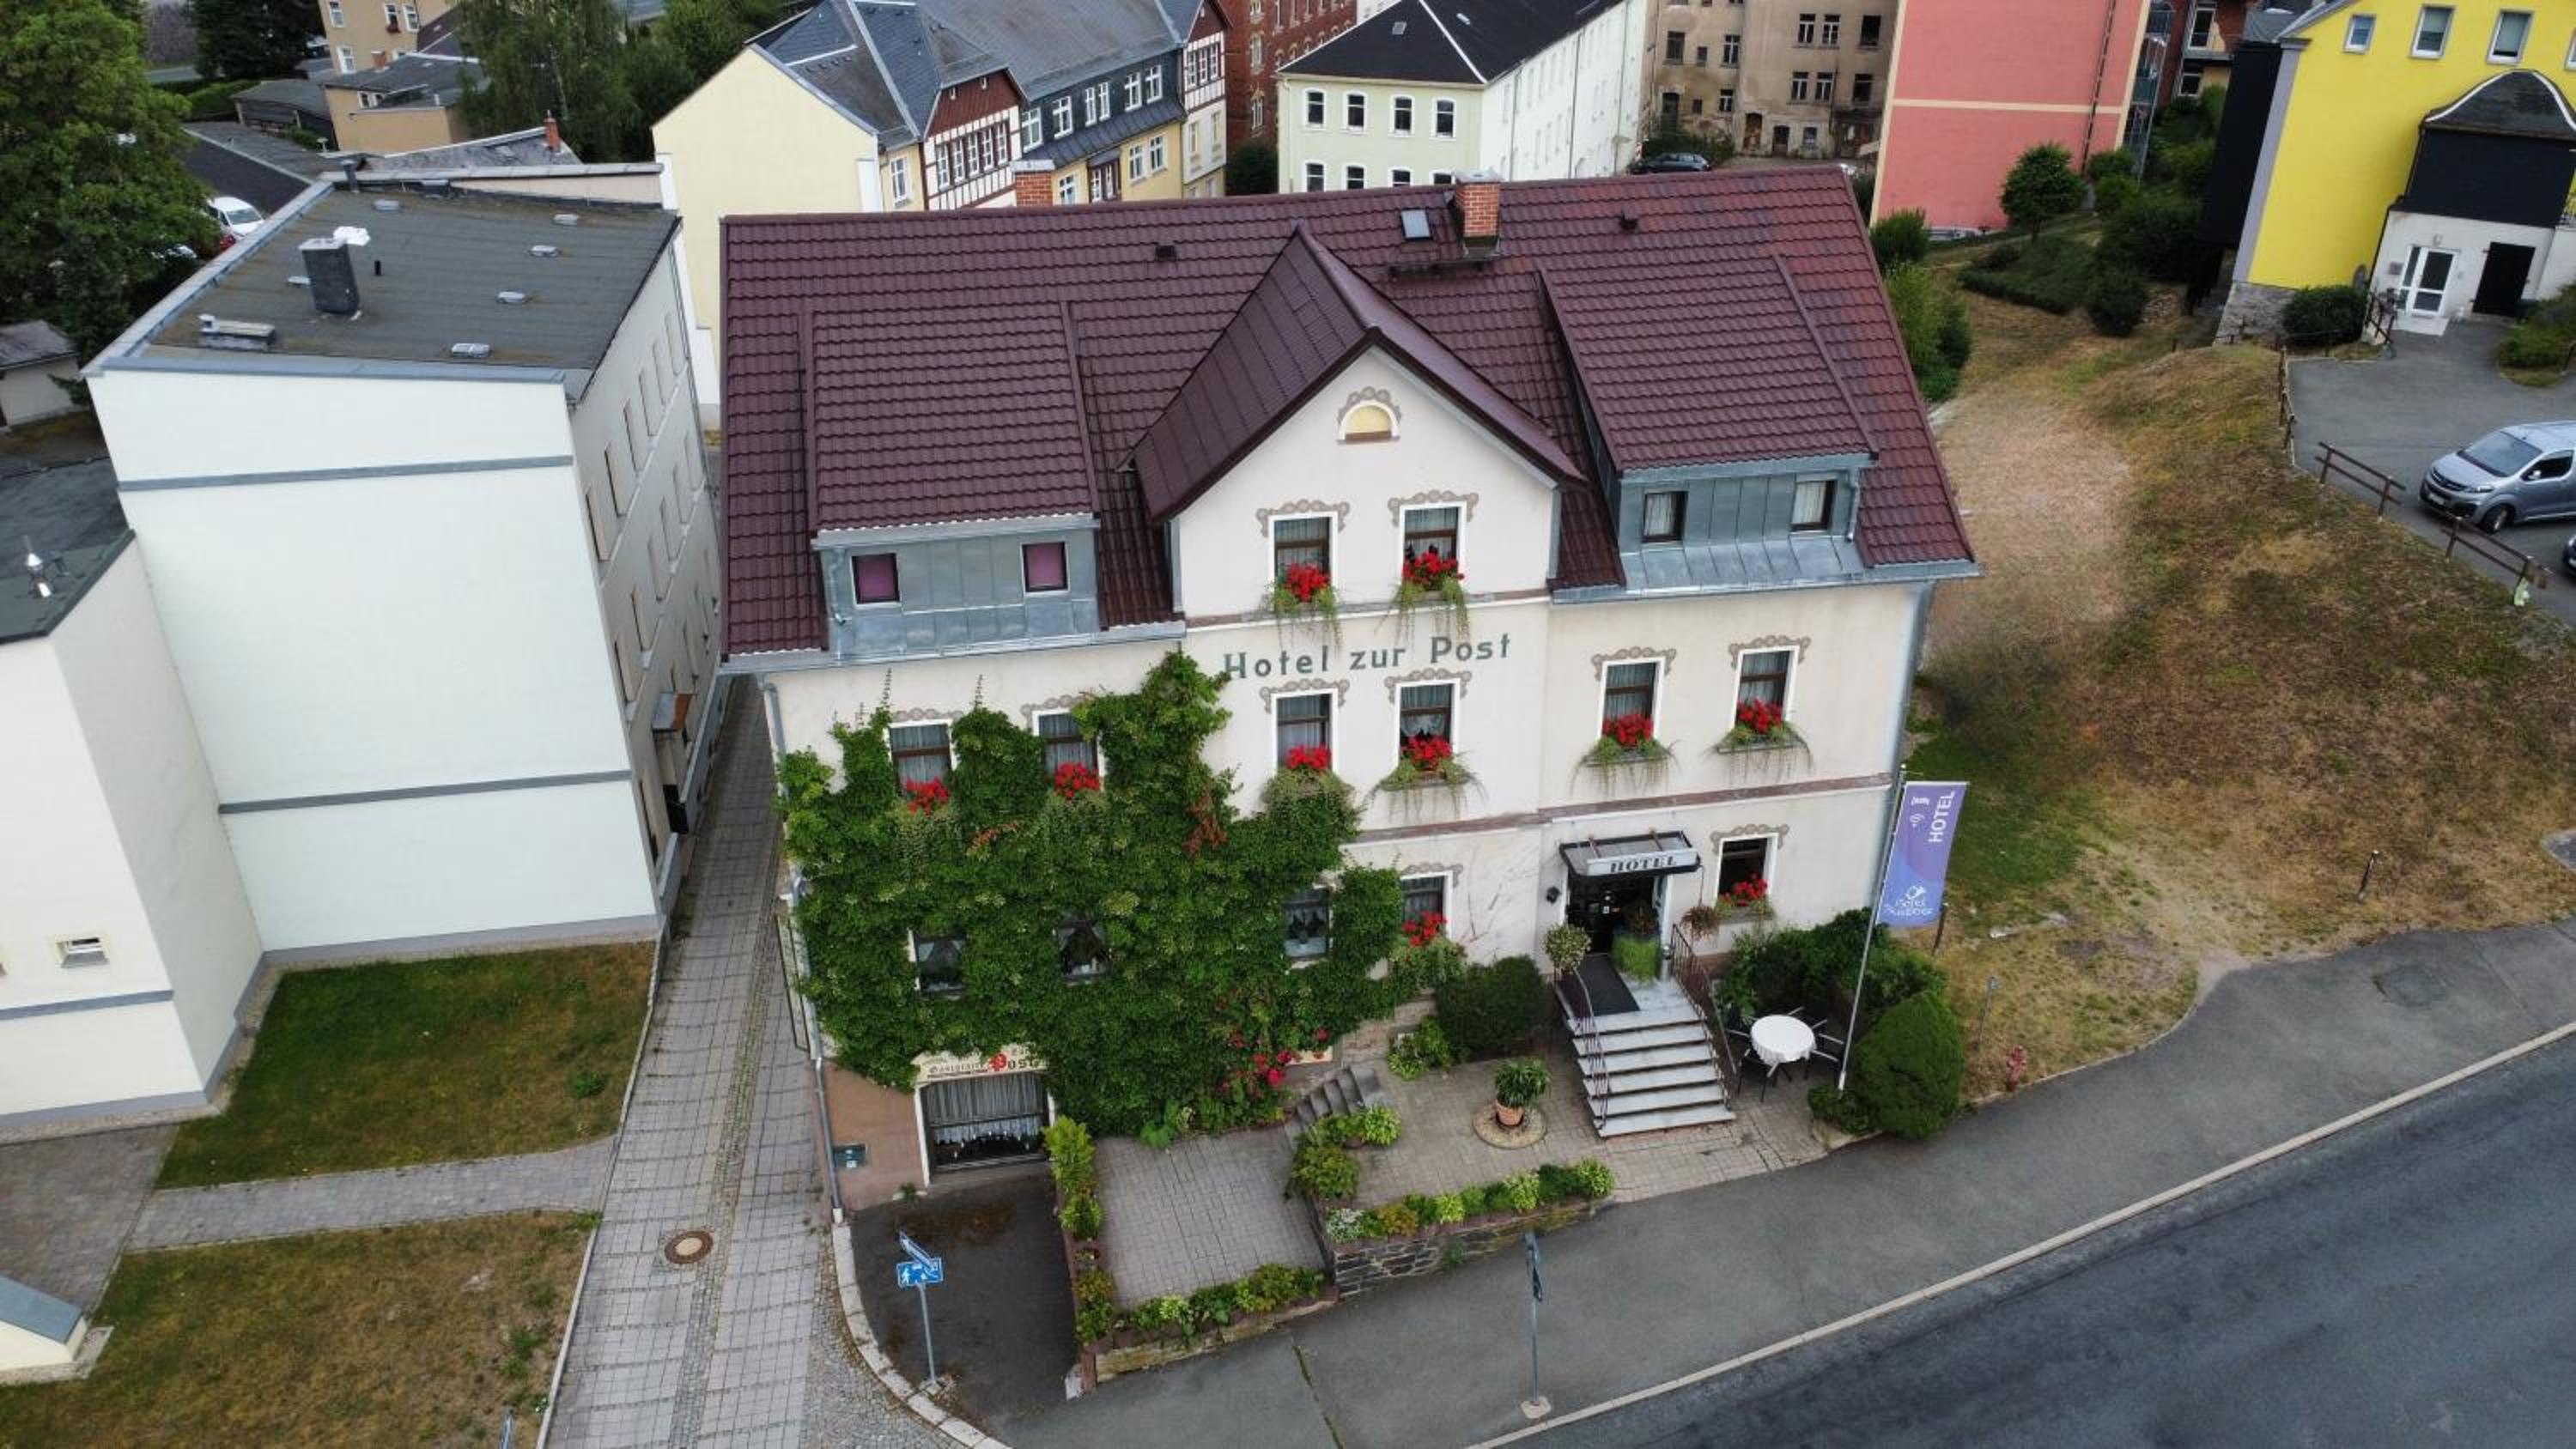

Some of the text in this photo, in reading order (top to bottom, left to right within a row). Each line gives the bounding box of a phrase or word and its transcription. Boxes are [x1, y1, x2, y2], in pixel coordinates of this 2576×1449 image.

[1223, 634, 1510, 678] Hotel zur Post
[1928, 791, 1955, 843] HOTEL
[1610, 857, 1677, 873] HOTEL
